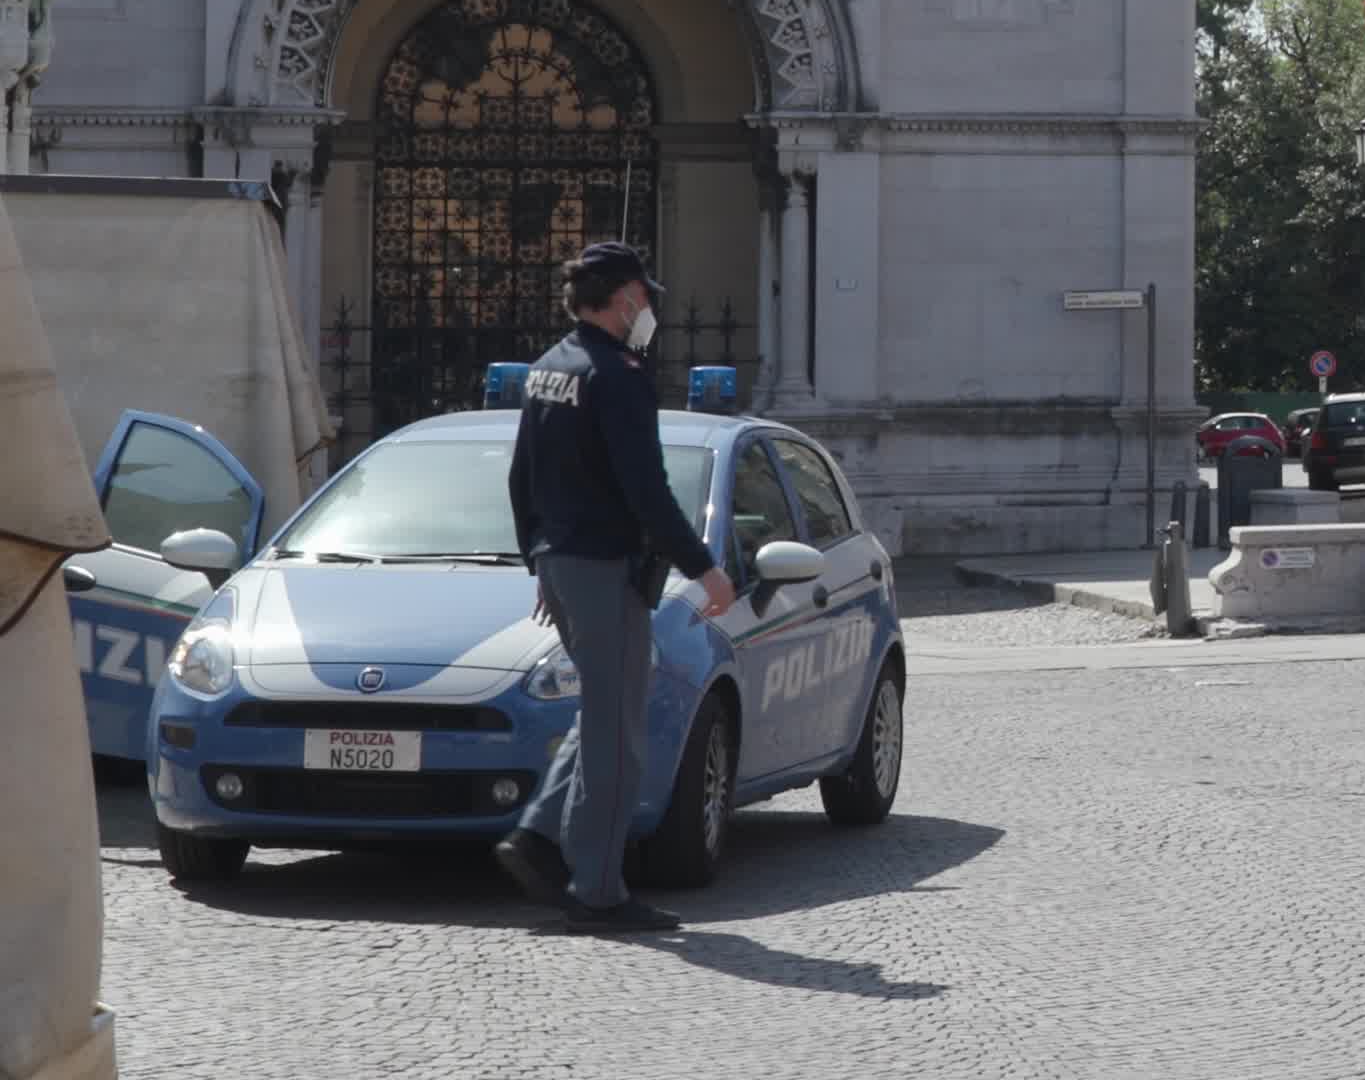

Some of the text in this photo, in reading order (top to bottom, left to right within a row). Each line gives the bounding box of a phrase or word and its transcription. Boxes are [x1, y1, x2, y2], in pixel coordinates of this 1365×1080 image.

[761, 614, 873, 712] POLIZIA
[329, 731, 395, 746] POLIZIA
[330, 748, 395, 769] N5020
